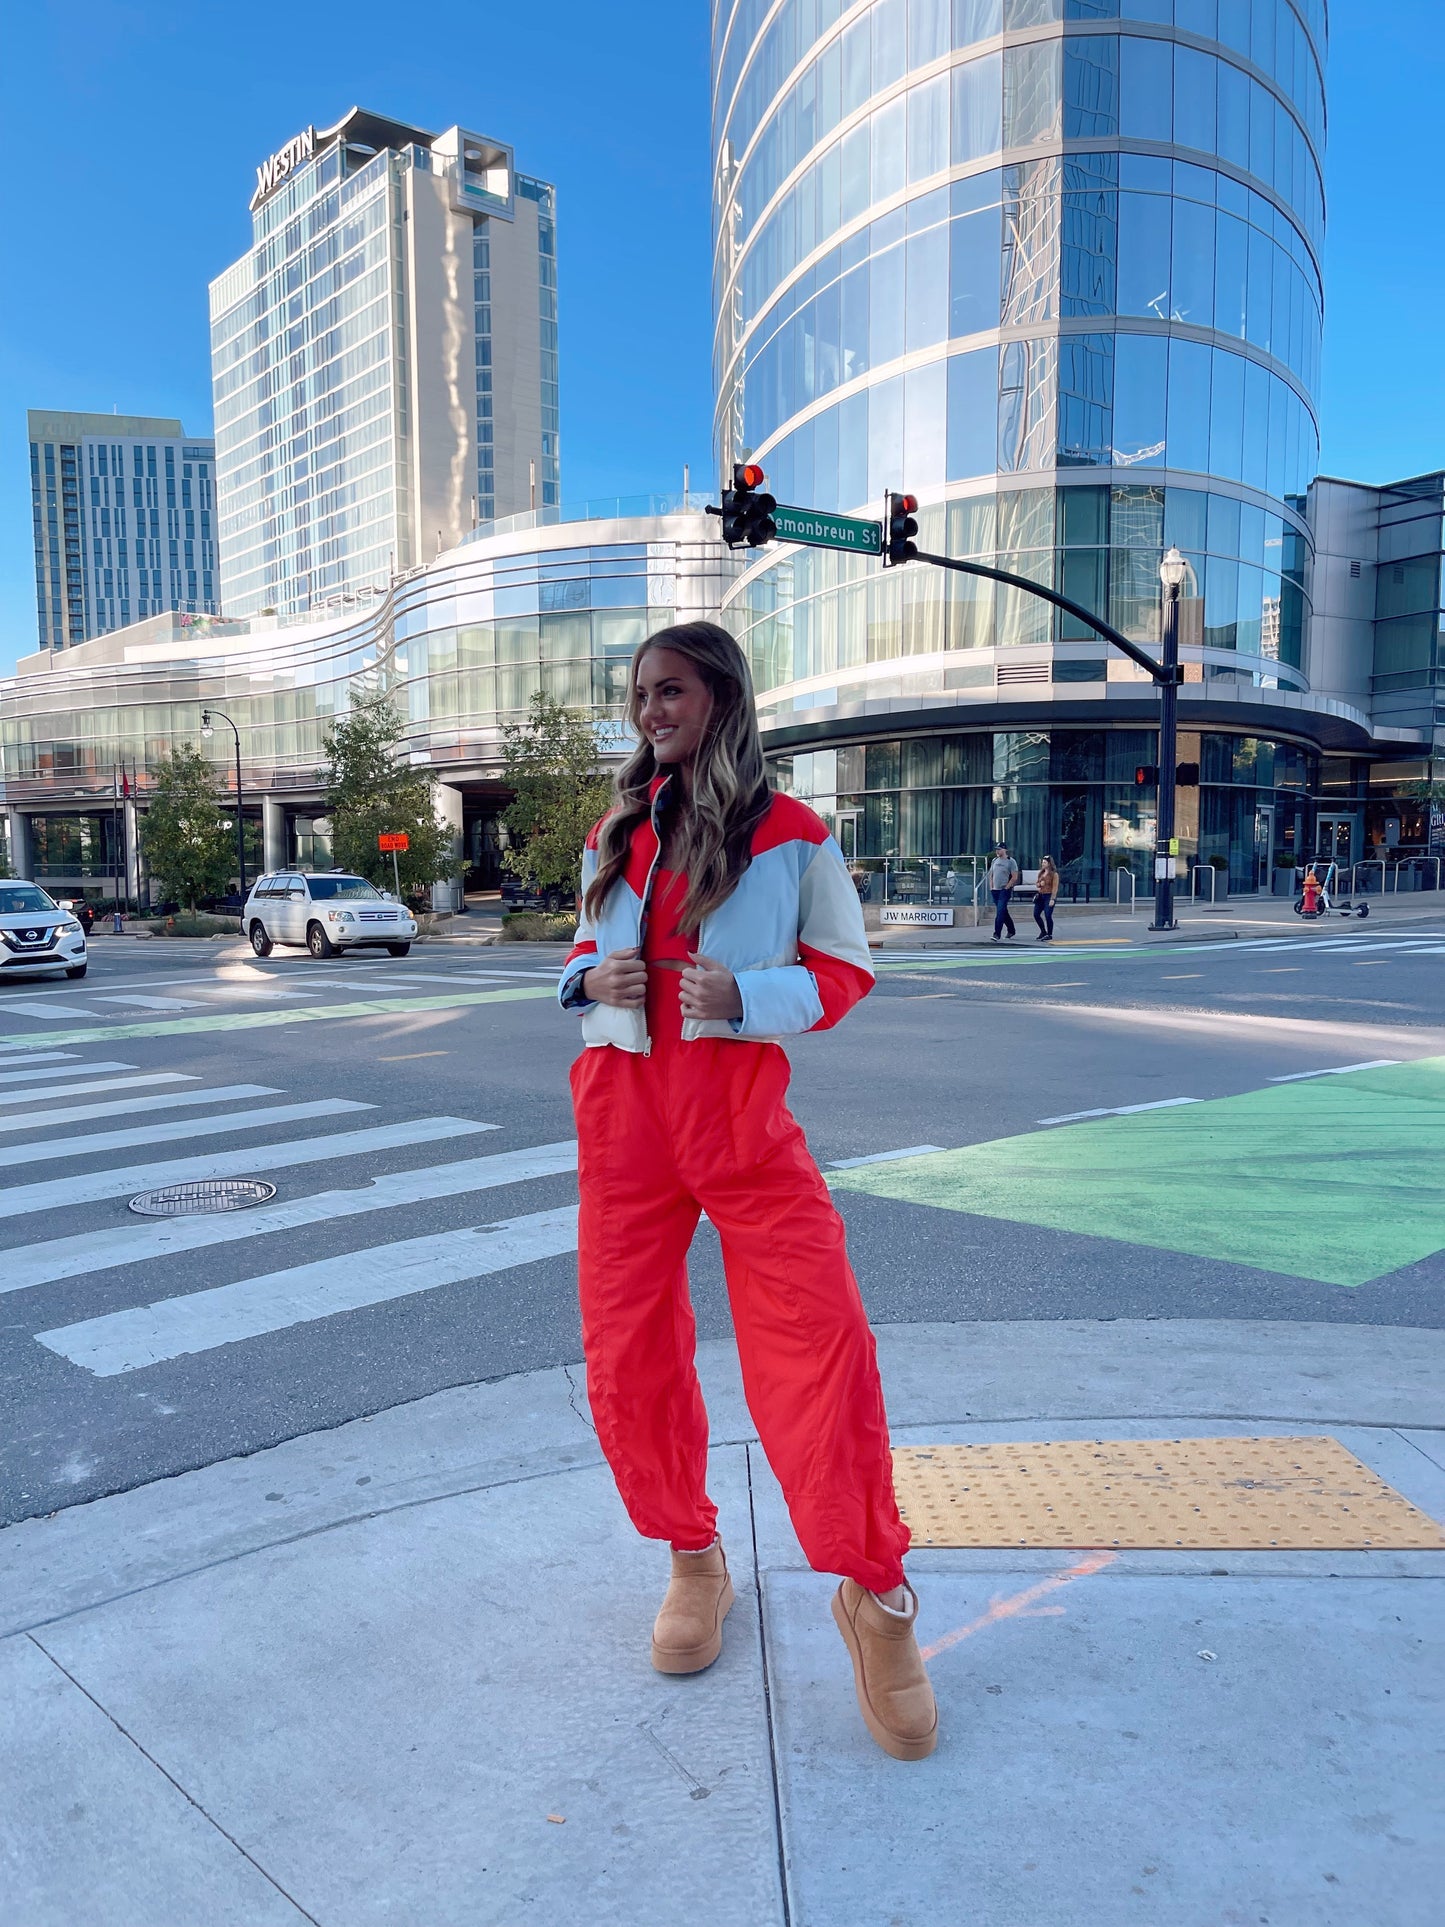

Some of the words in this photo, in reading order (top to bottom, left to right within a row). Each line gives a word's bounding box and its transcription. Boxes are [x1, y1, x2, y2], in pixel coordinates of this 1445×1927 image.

[256, 125, 314, 194] WESTIN
[862, 528, 877, 545] St
[884, 912, 898, 920] JW
[901, 912, 949, 921] MARRIOTT
